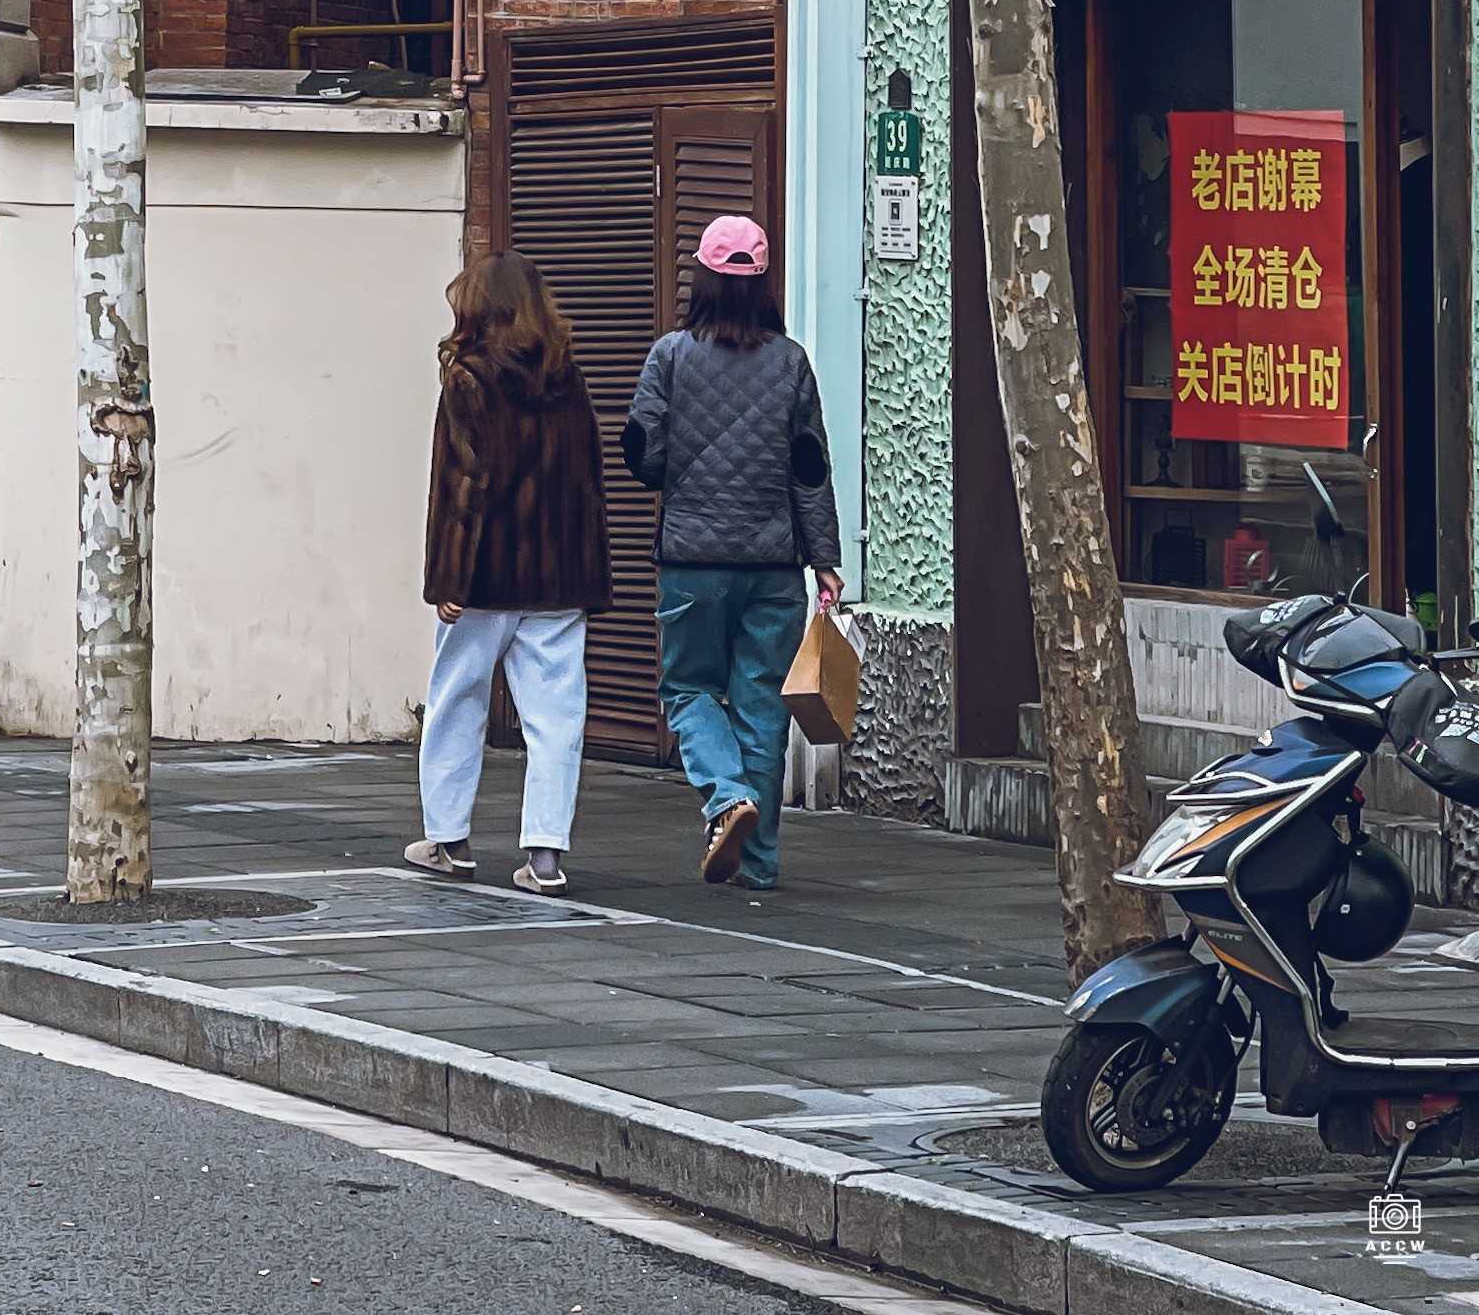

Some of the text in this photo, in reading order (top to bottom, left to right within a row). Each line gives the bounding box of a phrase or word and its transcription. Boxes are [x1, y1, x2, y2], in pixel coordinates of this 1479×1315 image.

[887, 120, 907, 152] 39
[1191, 148, 1322, 212] 老店谢幕
[1192, 244, 1323, 310] 全场清仓
[1177, 340, 1341, 411] 关店倒计时
